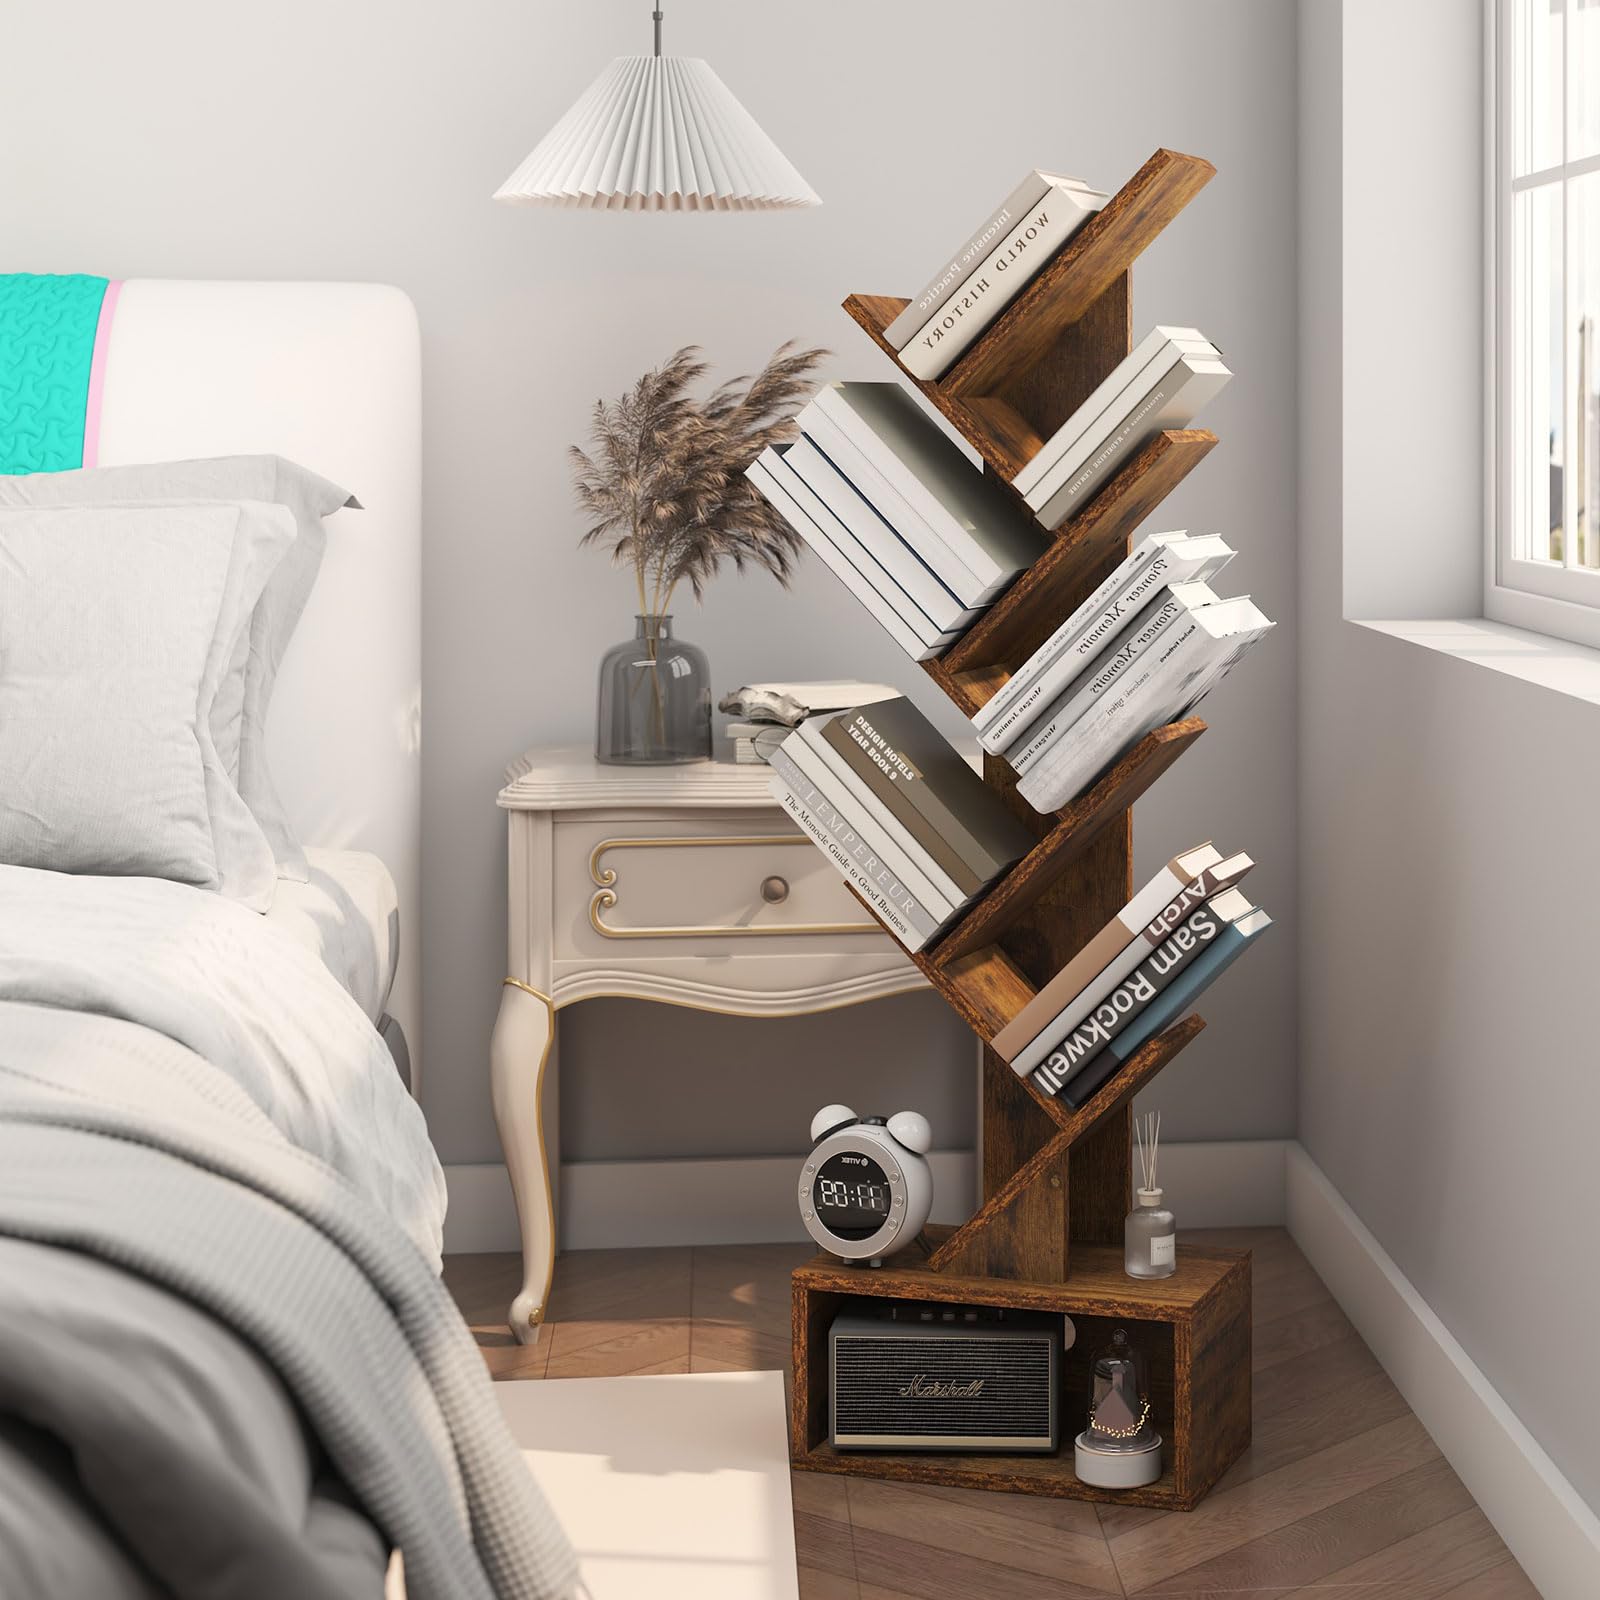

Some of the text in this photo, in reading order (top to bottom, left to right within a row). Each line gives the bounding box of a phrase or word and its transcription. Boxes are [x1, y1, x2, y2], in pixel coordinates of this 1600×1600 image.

[846, 724, 898, 781] YEAR BOOK 9
[855, 716, 915, 781] DESIGN HOTELS
[784, 792, 799, 812] The
[798, 810, 829, 846] Monocle
[828, 843, 850, 869] Guide
[849, 868, 858, 878] to
[858, 877, 880, 901] Good
[877, 899, 908, 935] Business
[805, 790, 914, 913] LEMPEREUR
[1148, 874, 1207, 937] Arch
[1033, 911, 1217, 1095] Sam Rockwell
[899, 1374, 985, 1397] Marshall
